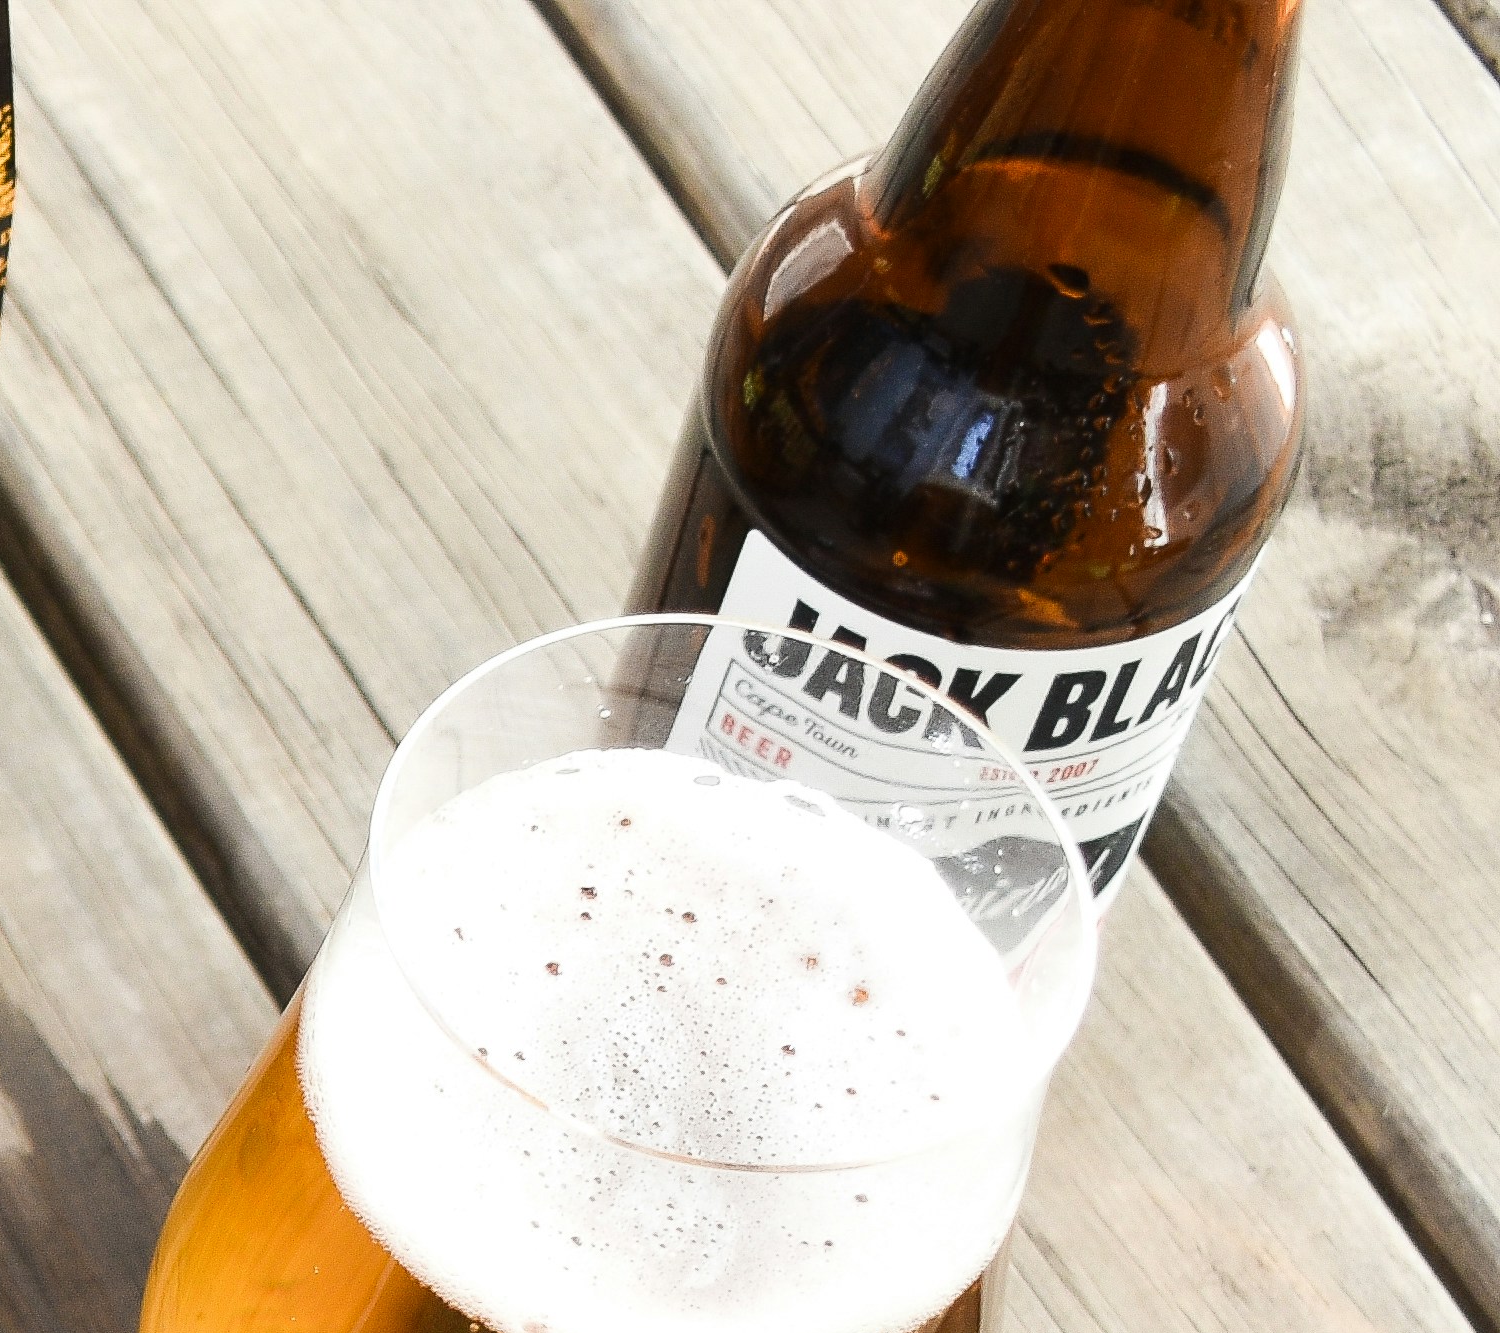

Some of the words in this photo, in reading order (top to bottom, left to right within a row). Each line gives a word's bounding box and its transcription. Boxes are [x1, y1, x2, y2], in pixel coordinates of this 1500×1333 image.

[742, 598, 1020, 751] JACK
[720, 712, 793, 770] BEER
[1046, 758, 1100, 784] 2007
[734, 679, 799, 726] Cape
[804, 717, 860, 760] Town
